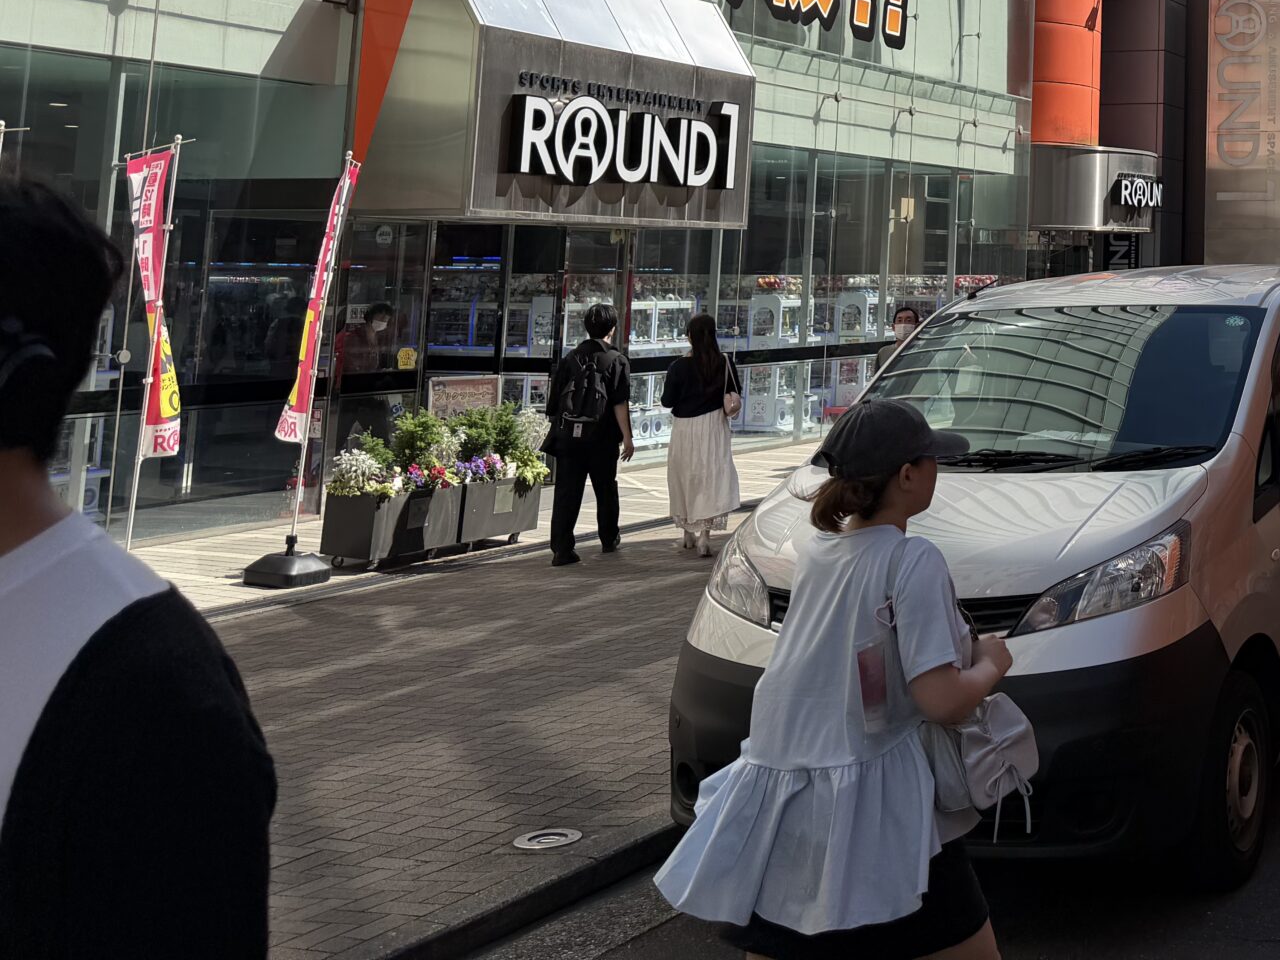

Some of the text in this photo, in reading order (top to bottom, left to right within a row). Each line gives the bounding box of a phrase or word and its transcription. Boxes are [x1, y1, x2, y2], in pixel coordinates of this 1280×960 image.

[519, 71, 705, 113] SPORTS ENTERTAINMENT
[520, 95, 740, 190] ROUND1
